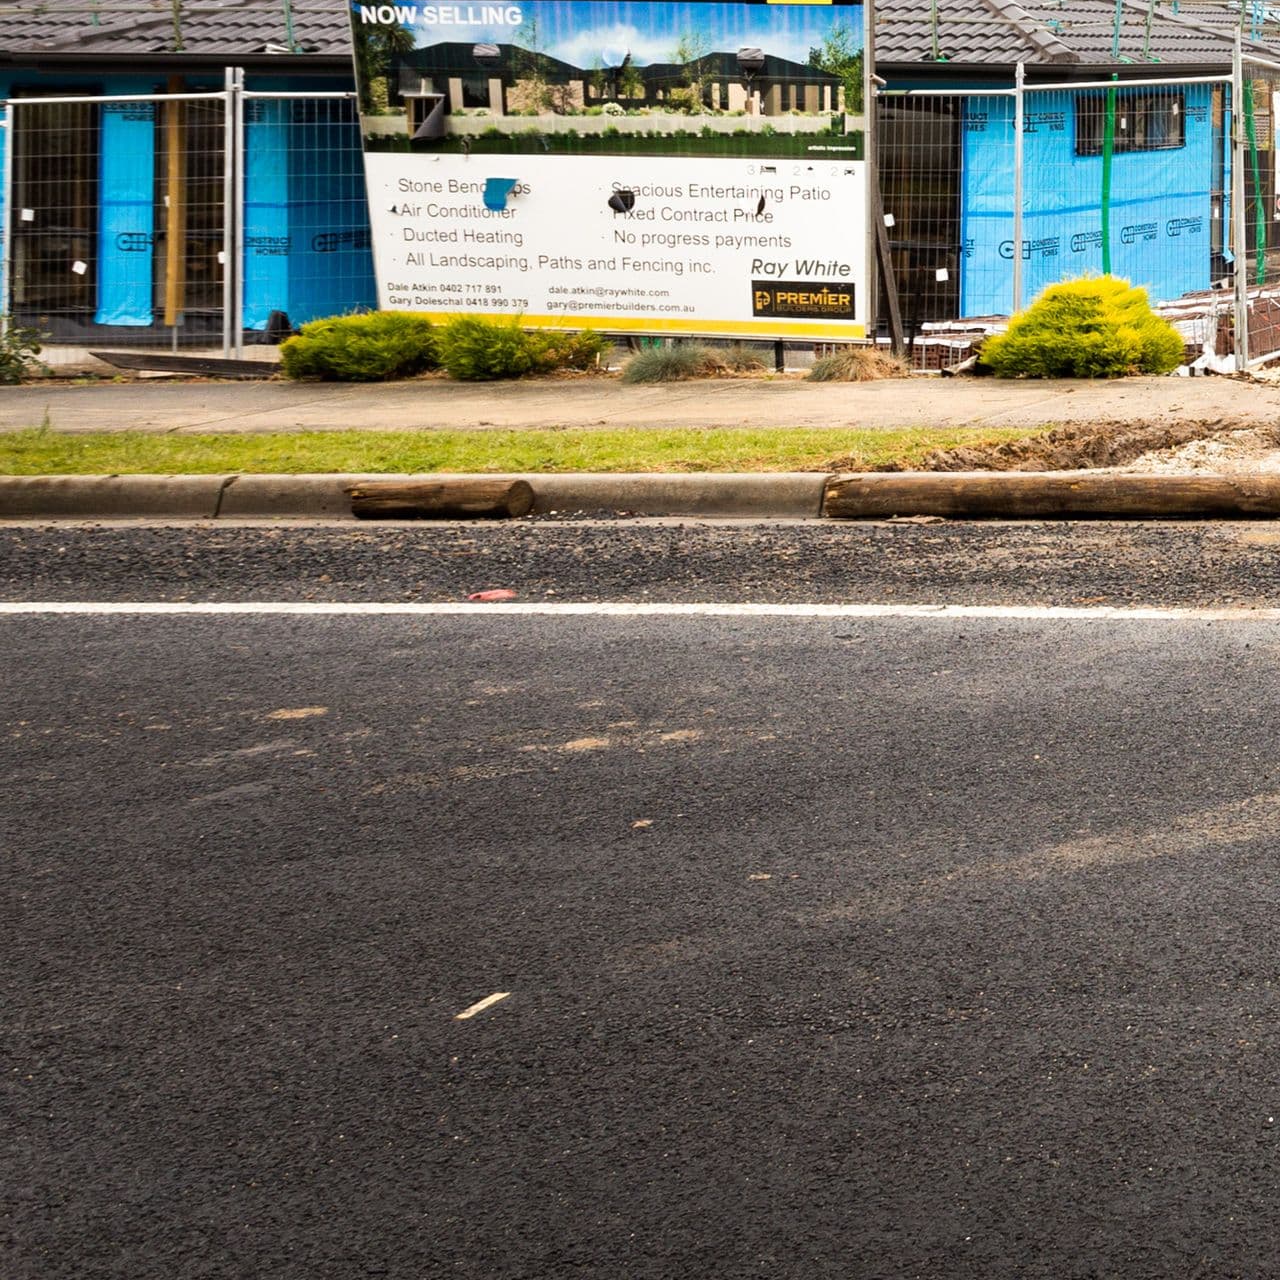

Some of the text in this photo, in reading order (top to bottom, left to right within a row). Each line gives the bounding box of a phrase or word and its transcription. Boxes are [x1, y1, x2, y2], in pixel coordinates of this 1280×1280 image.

[360, 5, 523, 26] NOW SELLING
[398, 178, 443, 193] Stone
[689, 183, 784, 203] Entertaining
[790, 186, 831, 201] Patio
[400, 203, 518, 219] Air Conditioner
[661, 207, 728, 222] Contract
[403, 227, 524, 247] Ducted Heating
[614, 230, 792, 249] No progress payments
[405, 252, 425, 266] All
[538, 255, 582, 269] Paths
[588, 256, 616, 271] and
[622, 257, 684, 276] Fencing
[688, 258, 716, 273] inc.
[750, 258, 851, 278] Ray White
[387, 282, 502, 294] Dale Atkin 0402 717 891
[548, 286, 670, 298] dale.atkin@raywhite.com
[389, 296, 529, 308] Gary Doleschal 0418 990 379
[546, 300, 696, 313] gary@premierbuilders.com.au
